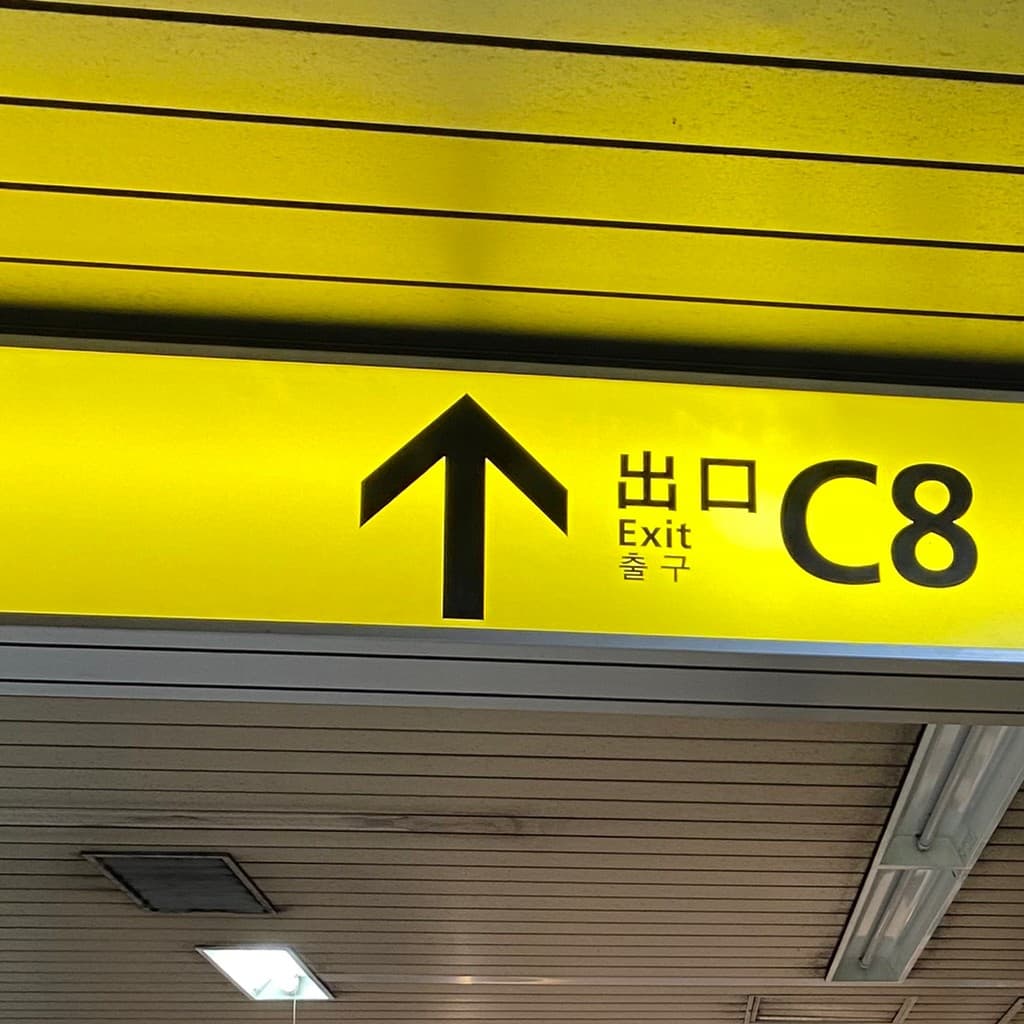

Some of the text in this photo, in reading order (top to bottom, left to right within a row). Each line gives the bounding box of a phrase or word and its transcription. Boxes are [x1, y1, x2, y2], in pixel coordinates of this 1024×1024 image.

[618, 451, 757, 513] 出口
[619, 519, 691, 549] Exit
[780, 459, 978, 589] C8
